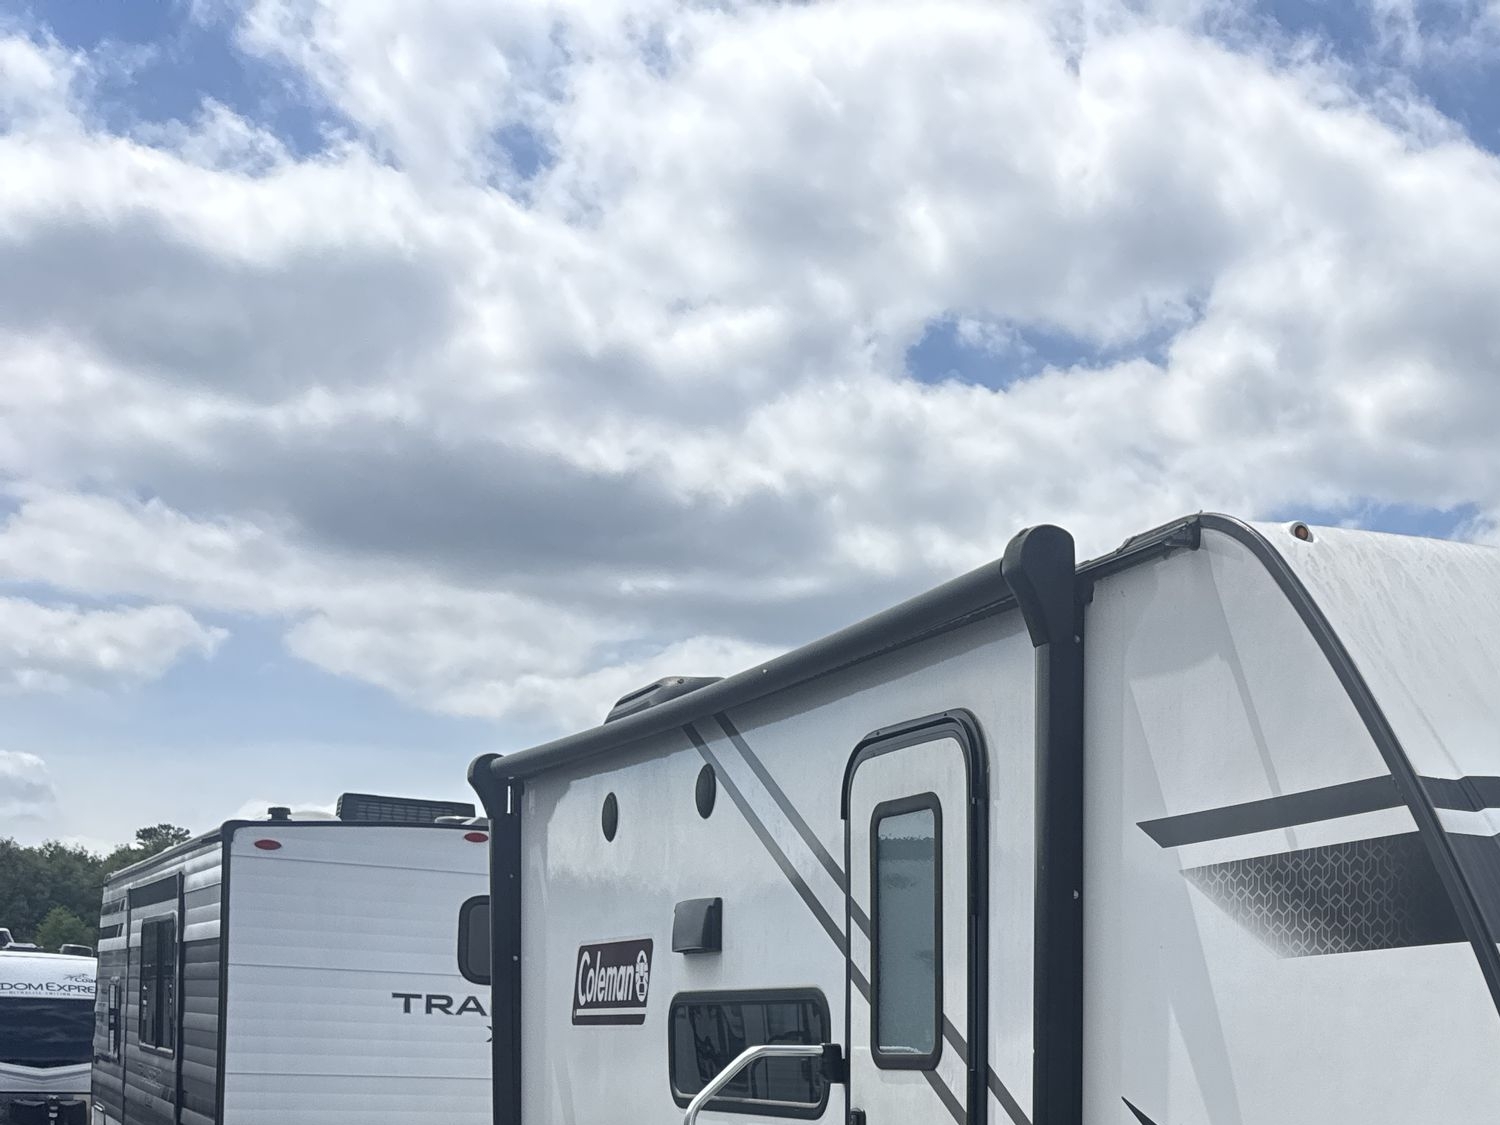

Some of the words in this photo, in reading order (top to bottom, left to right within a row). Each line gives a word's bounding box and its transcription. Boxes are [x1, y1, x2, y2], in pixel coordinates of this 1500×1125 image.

[0, 982, 44, 991] DOM
[45, 982, 96, 994] EXPRE
[577, 950, 635, 1006] Coleman
[391, 992, 488, 1017] TRA
